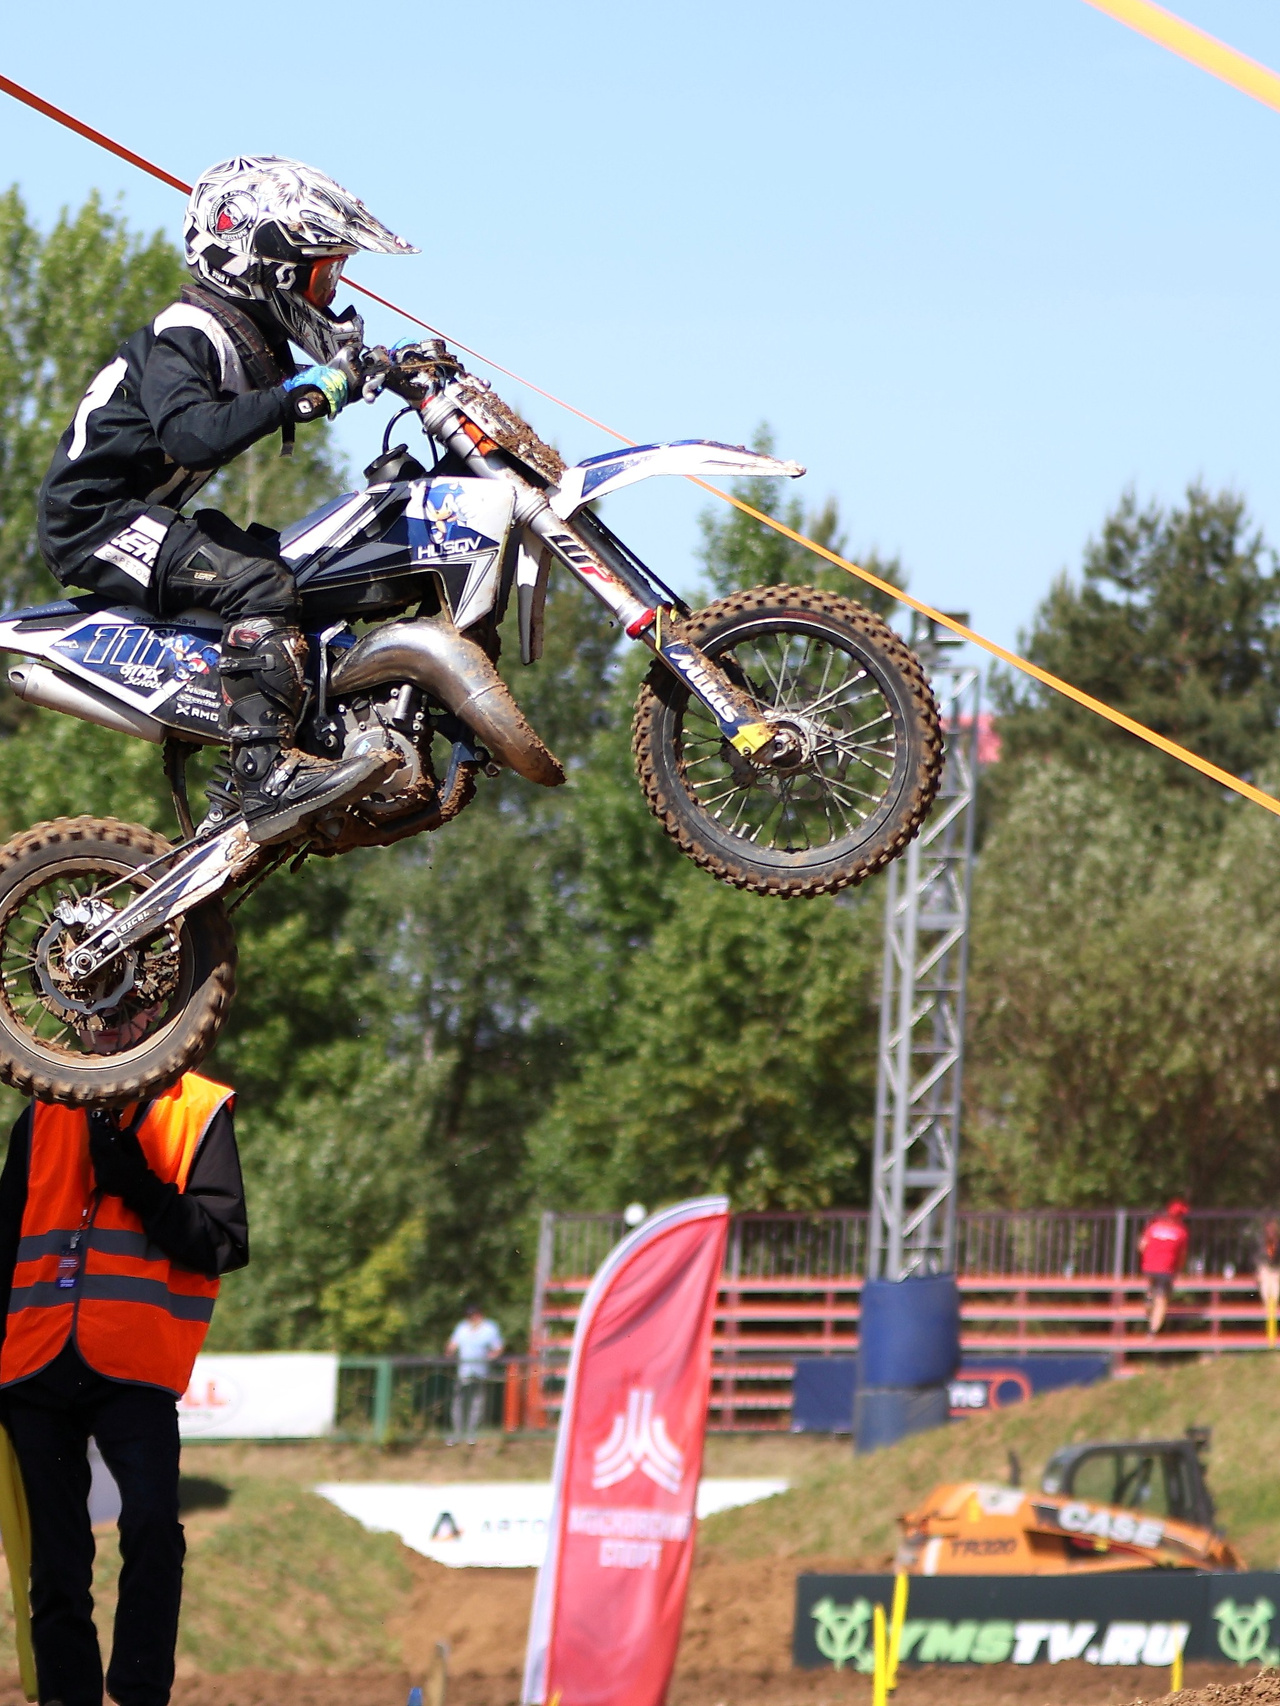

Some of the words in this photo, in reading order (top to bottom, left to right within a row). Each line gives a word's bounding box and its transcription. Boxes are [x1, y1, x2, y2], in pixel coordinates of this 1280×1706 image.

[110, 527, 160, 568] LEA
[417, 536, 482, 560] HUSQV
[83, 625, 176, 669] 111
[120, 663, 164, 682] GTMX
[123, 676, 163, 691] SCHOOL
[669, 652, 739, 723] Mitas
[1058, 1502, 1165, 1550] CASE
